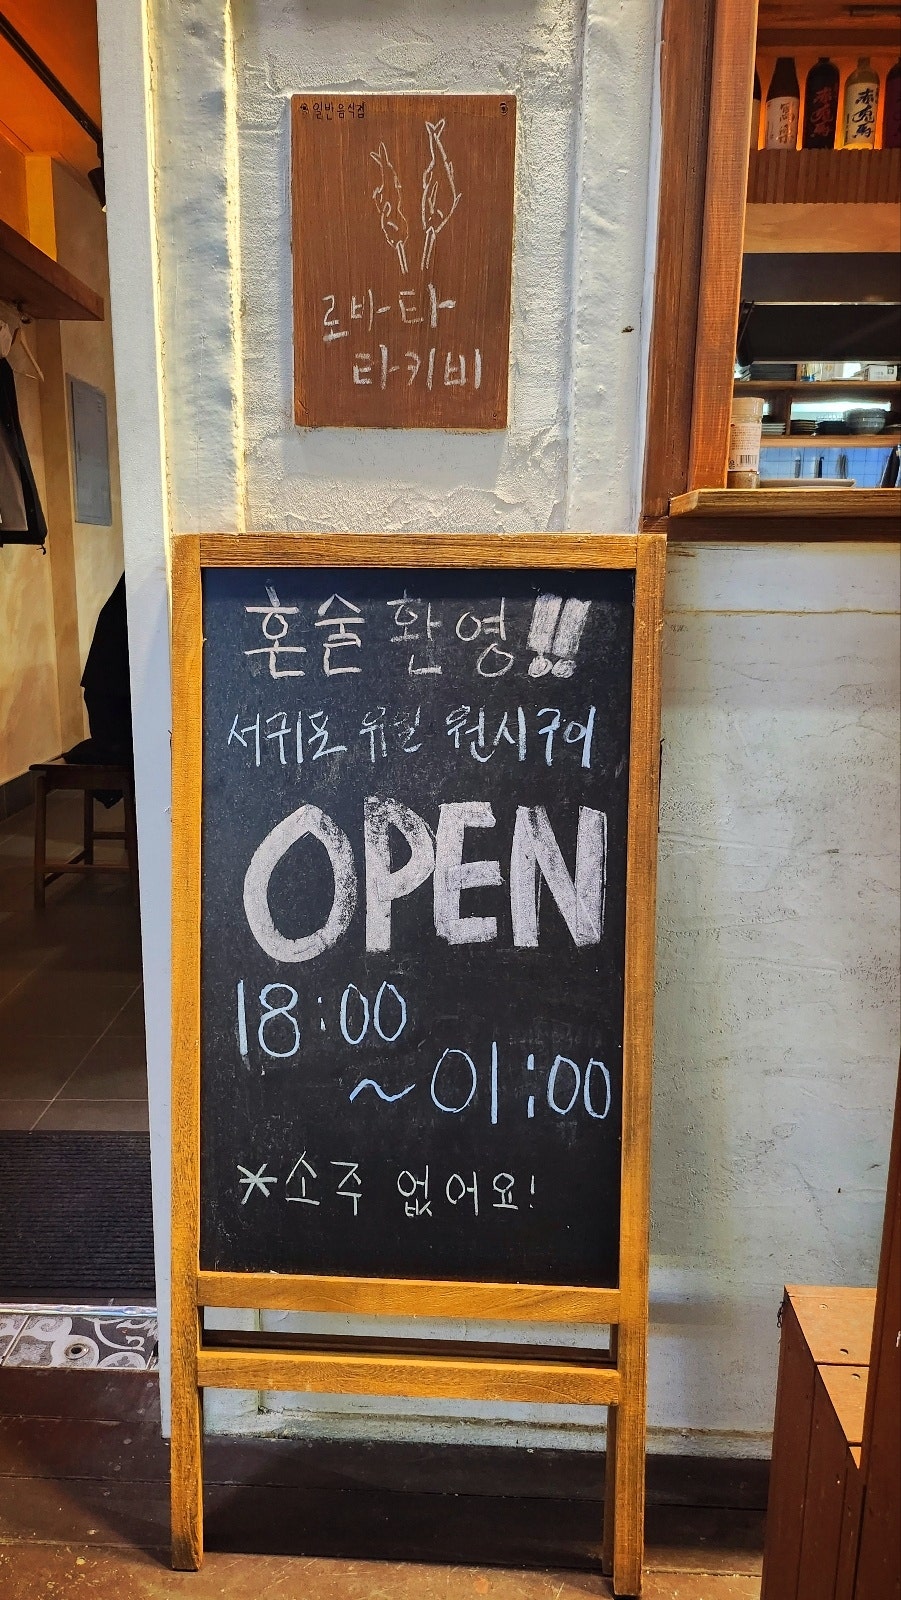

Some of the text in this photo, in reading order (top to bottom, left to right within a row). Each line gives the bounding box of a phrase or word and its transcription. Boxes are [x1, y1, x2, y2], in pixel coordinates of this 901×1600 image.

[352, 344, 482, 391] 타키비
[244, 582, 366, 679] 혼술
[227, 709, 348, 768] 서귀포
[243, 796, 608, 963] OPEN
[237, 979, 407, 1059] 18:00
